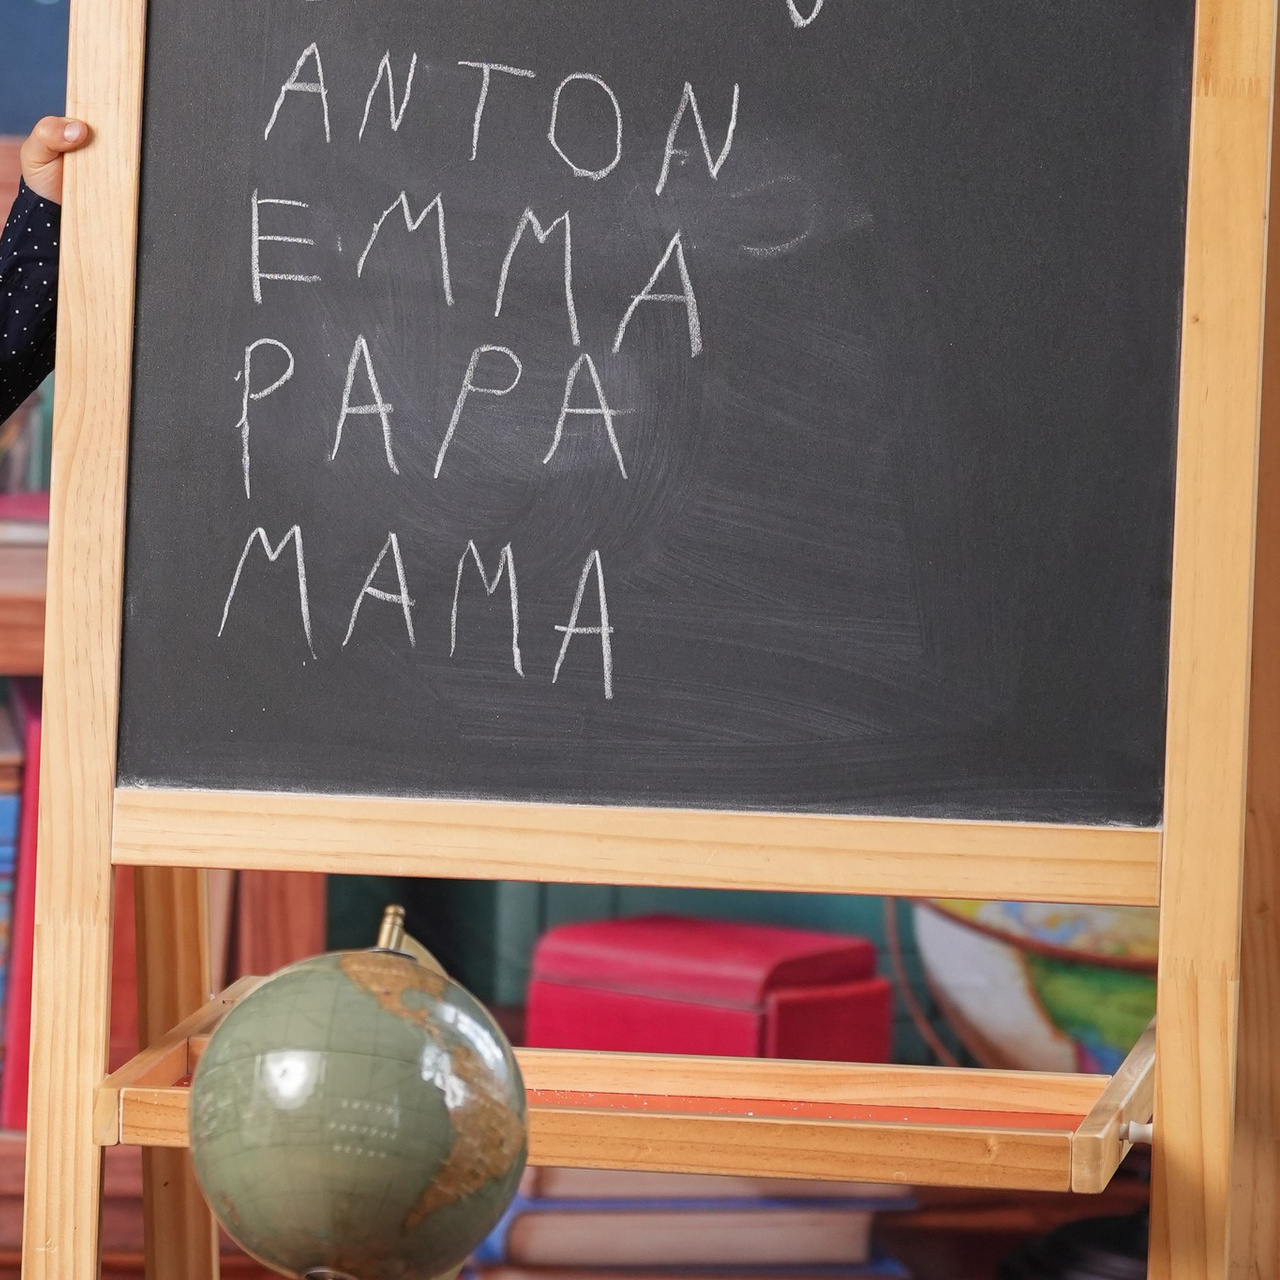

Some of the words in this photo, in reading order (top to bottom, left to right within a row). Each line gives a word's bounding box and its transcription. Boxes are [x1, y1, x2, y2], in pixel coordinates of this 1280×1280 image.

[263, 41, 741, 196] ANTON
[250, 190, 703, 357] EMMA
[233, 334, 630, 499] PAPA
[217, 523, 616, 701] MAMA
